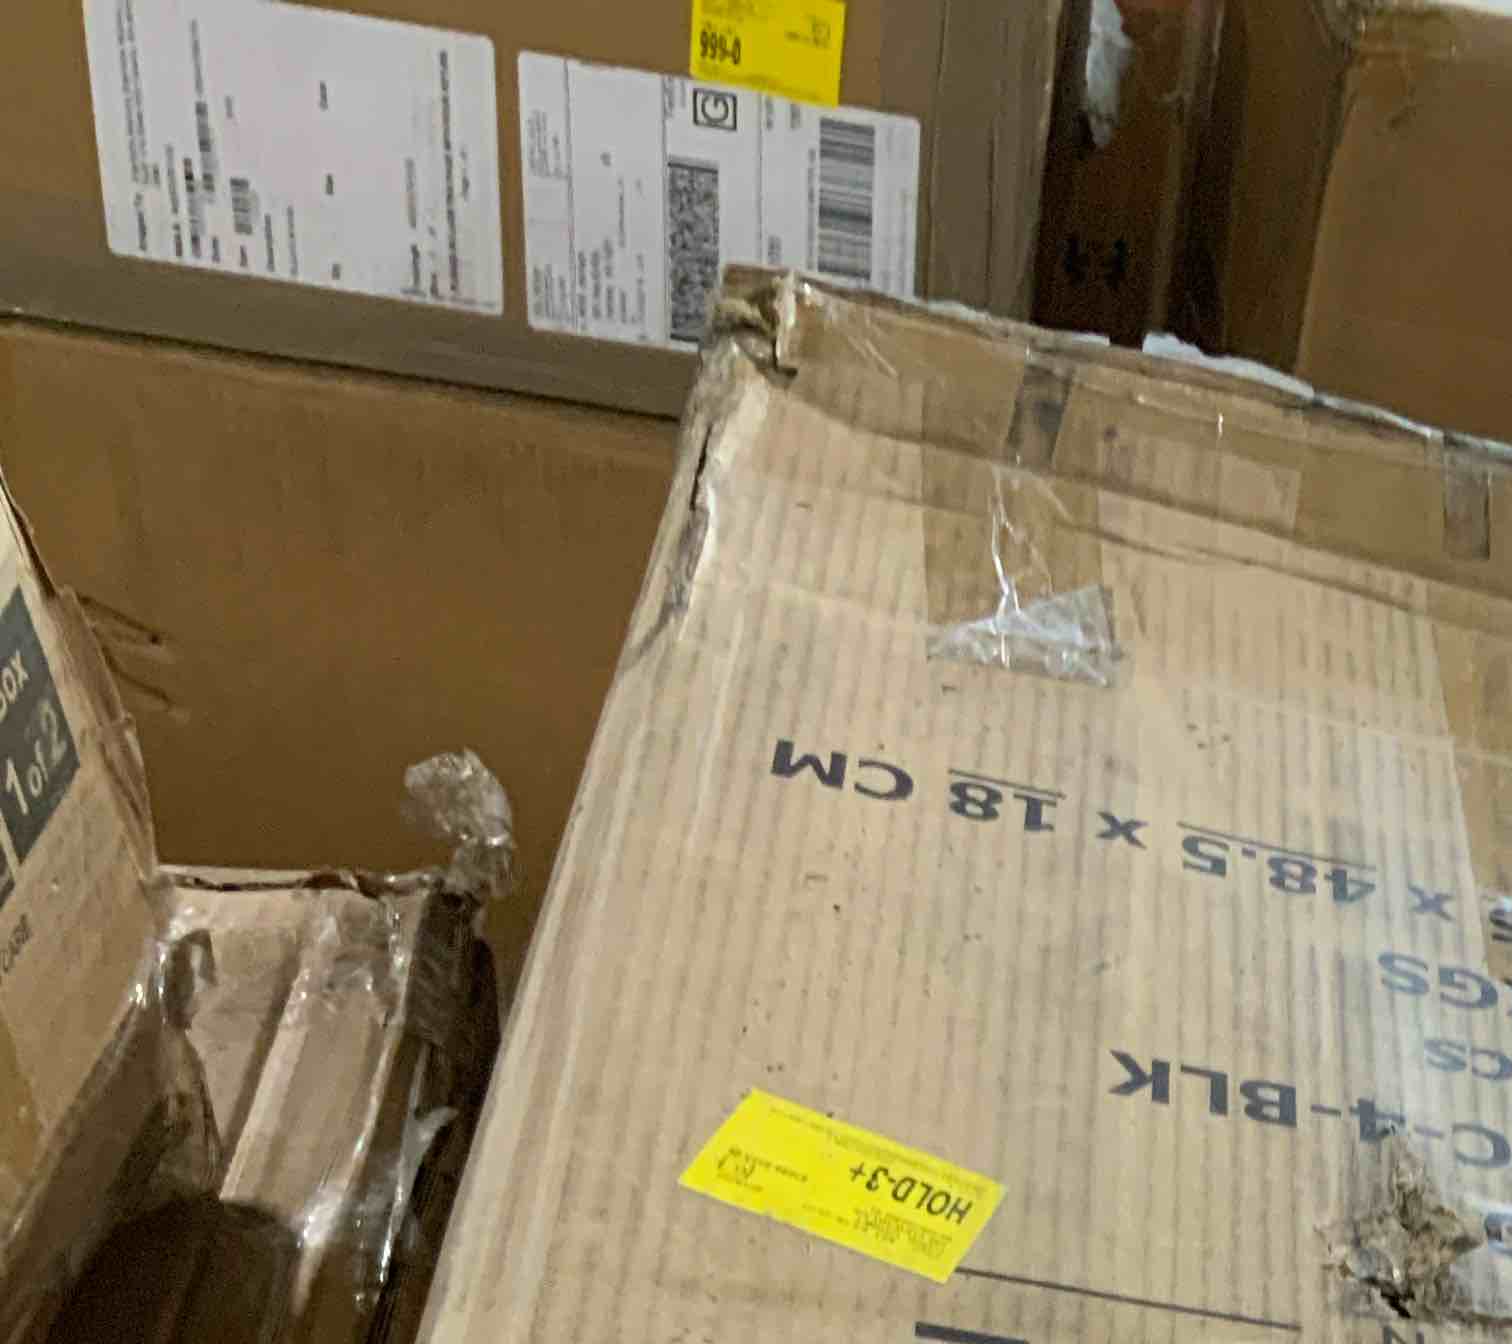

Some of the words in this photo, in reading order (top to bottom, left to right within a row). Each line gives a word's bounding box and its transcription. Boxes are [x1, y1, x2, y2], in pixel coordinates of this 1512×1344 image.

[5, 755, 29, 816] 1
[769, 739, 915, 802] CM
[947, 778, 1059, 832] 18
[1097, 811, 1148, 850] x
[1178, 830, 1377, 905] 48.5
